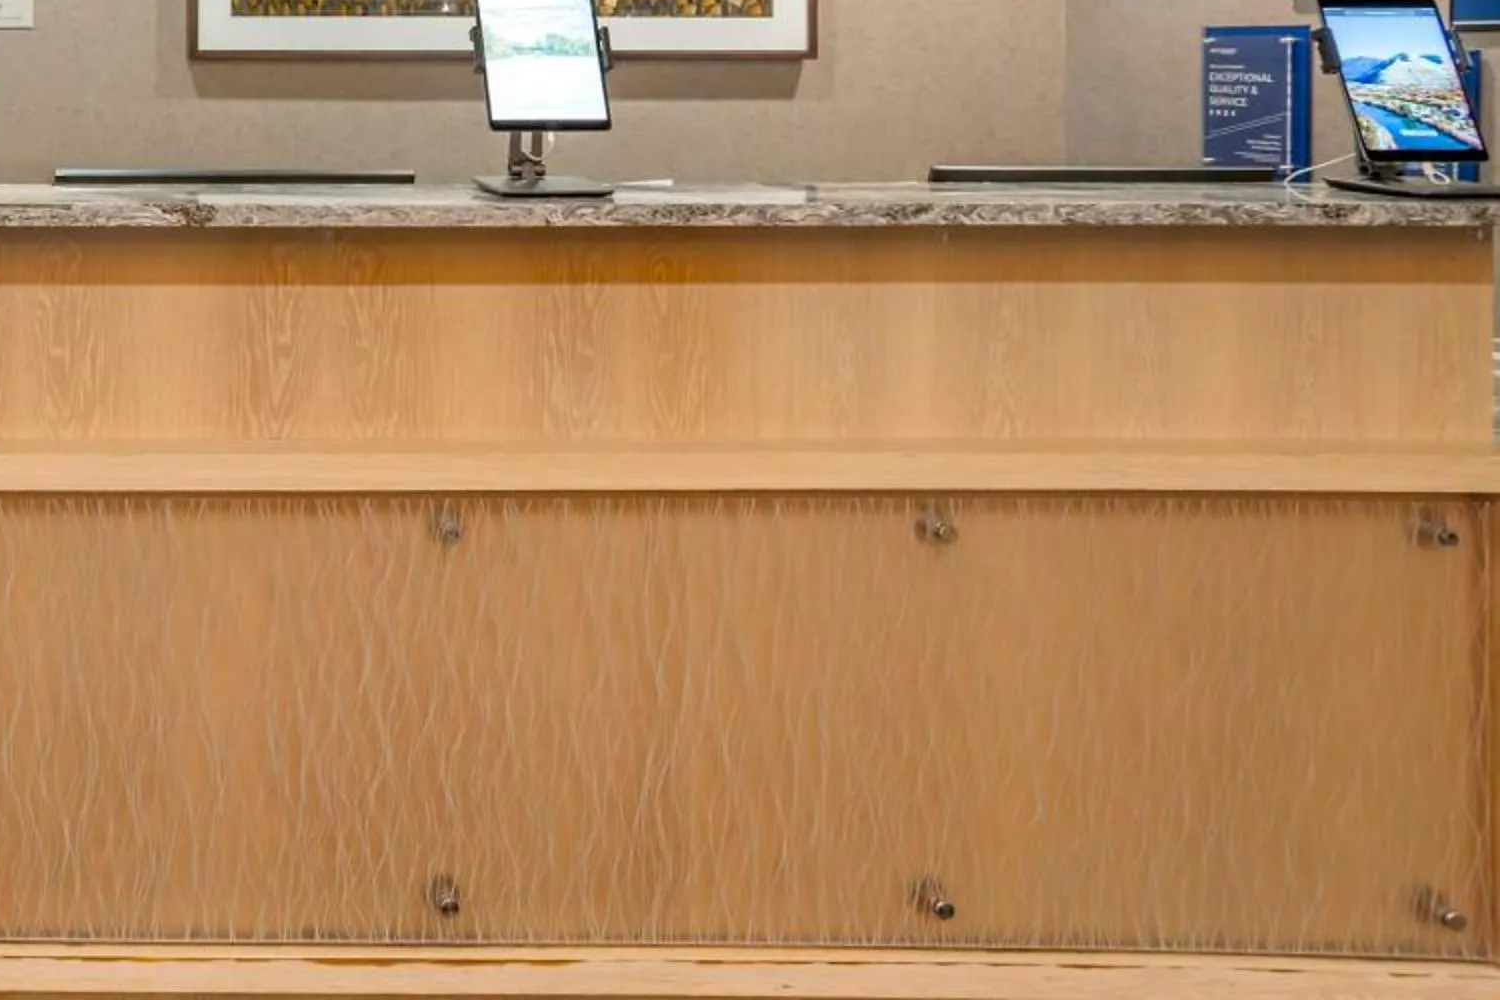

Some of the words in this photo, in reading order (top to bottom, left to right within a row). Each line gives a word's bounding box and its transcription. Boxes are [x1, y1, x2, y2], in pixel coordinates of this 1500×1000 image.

[1209, 71, 1274, 83] EXCEPTIONAL
[1209, 84, 1248, 95] QUALITY
[1209, 96, 1248, 107] SERVICE
